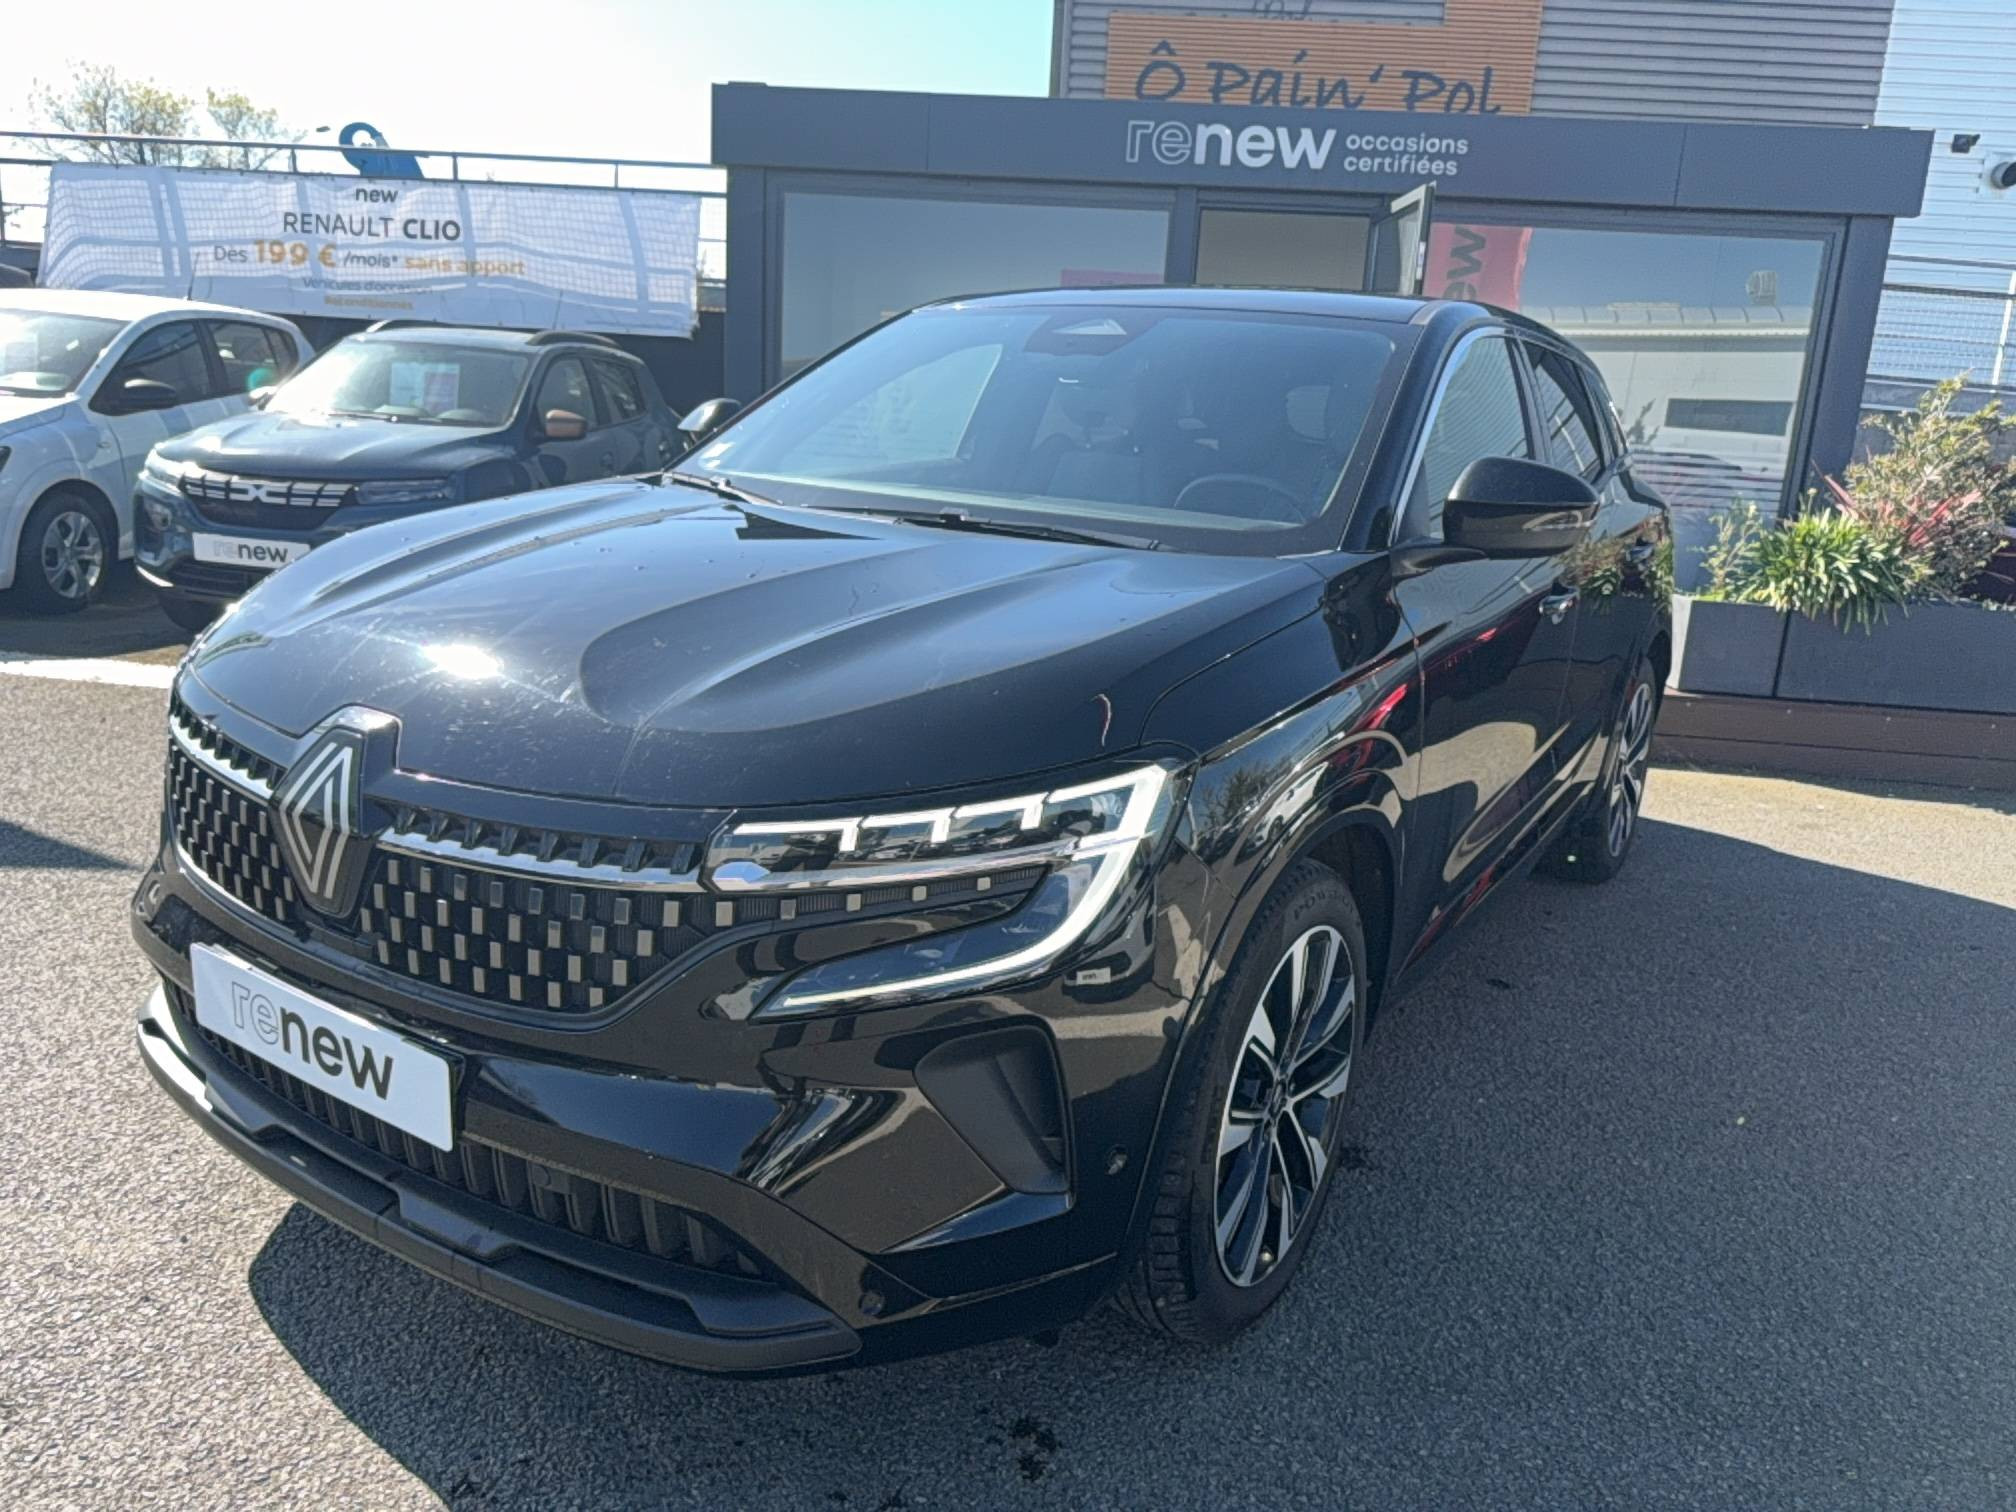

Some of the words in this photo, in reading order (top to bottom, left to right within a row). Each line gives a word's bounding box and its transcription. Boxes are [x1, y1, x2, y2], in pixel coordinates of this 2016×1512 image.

[1135, 40, 1186, 101] Ô
[1402, 66, 1502, 113] Pol
[1126, 120, 1337, 171] renew
[1345, 132, 1469, 155] occasions
[1343, 154, 1459, 176] certifiées
[355, 187, 398, 203] new
[283, 211, 394, 238] RENAULT
[402, 218, 461, 241] CLIO
[254, 239, 309, 267] 199
[318, 242, 337, 268] €
[404, 256, 452, 272] sans
[457, 258, 526, 277] apport
[214, 540, 288, 562] renew
[232, 981, 394, 1100] renew
